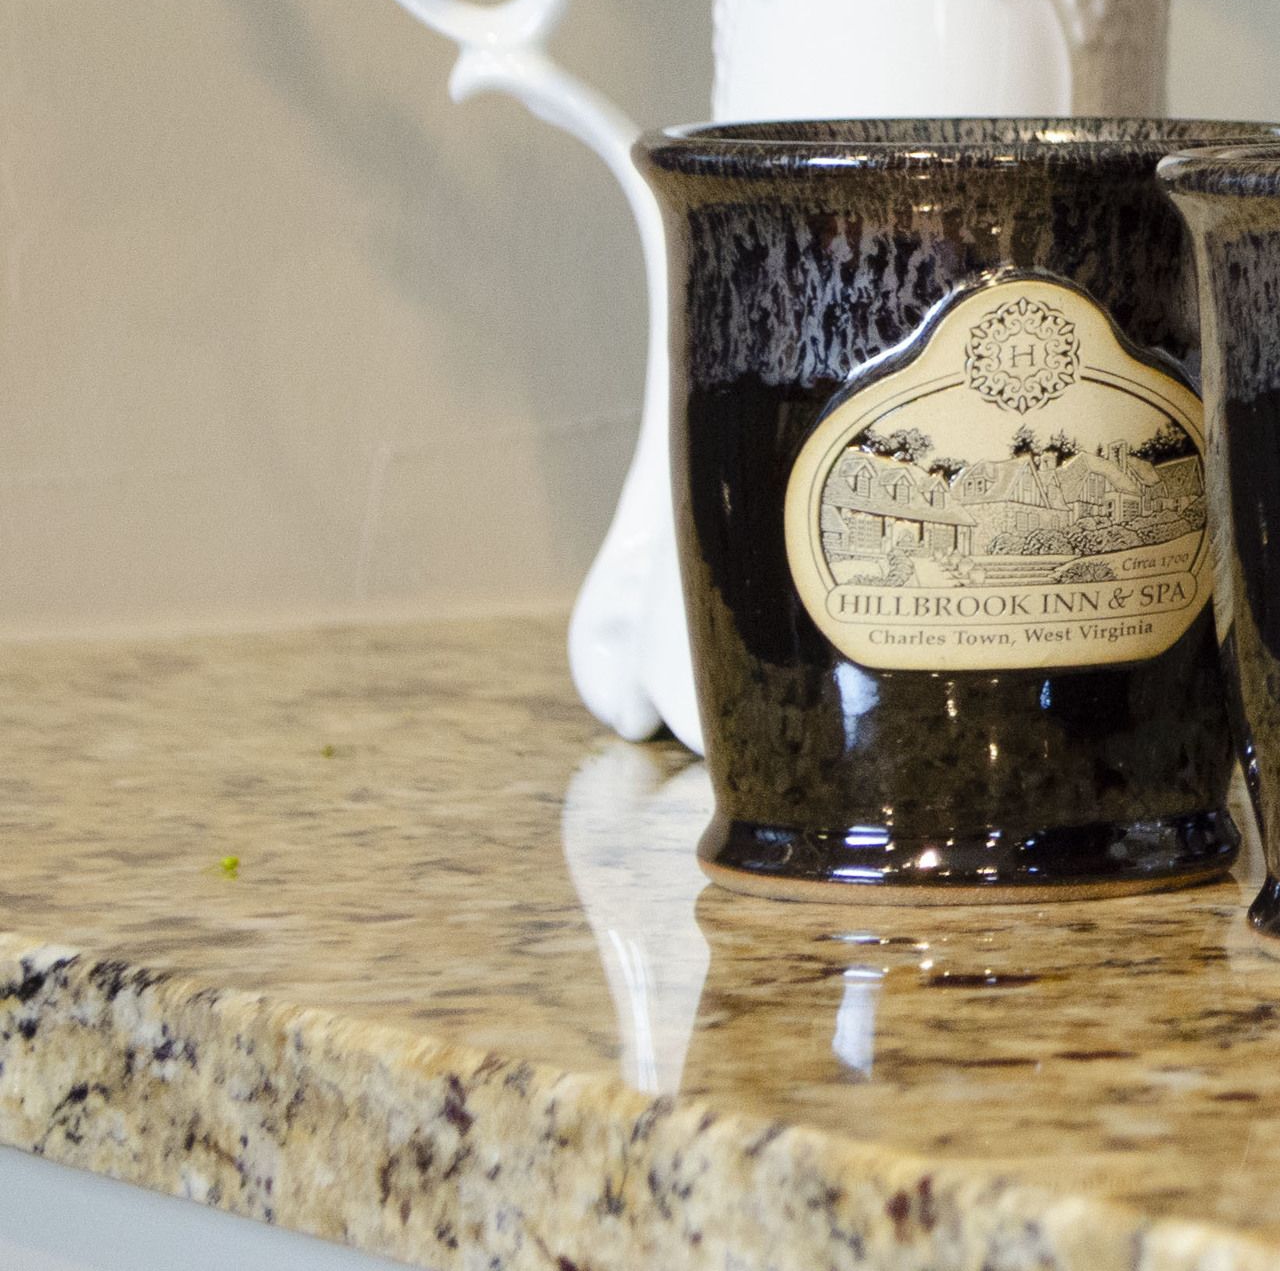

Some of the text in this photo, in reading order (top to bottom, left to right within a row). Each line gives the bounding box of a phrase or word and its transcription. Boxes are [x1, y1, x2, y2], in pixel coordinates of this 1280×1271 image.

[1009, 343, 1036, 368] H
[1122, 551, 1190, 572] Circa 1700
[838, 581, 1186, 618] HILLBROOK INN & SPA
[868, 620, 1154, 648] Charles Town, West Virginia
